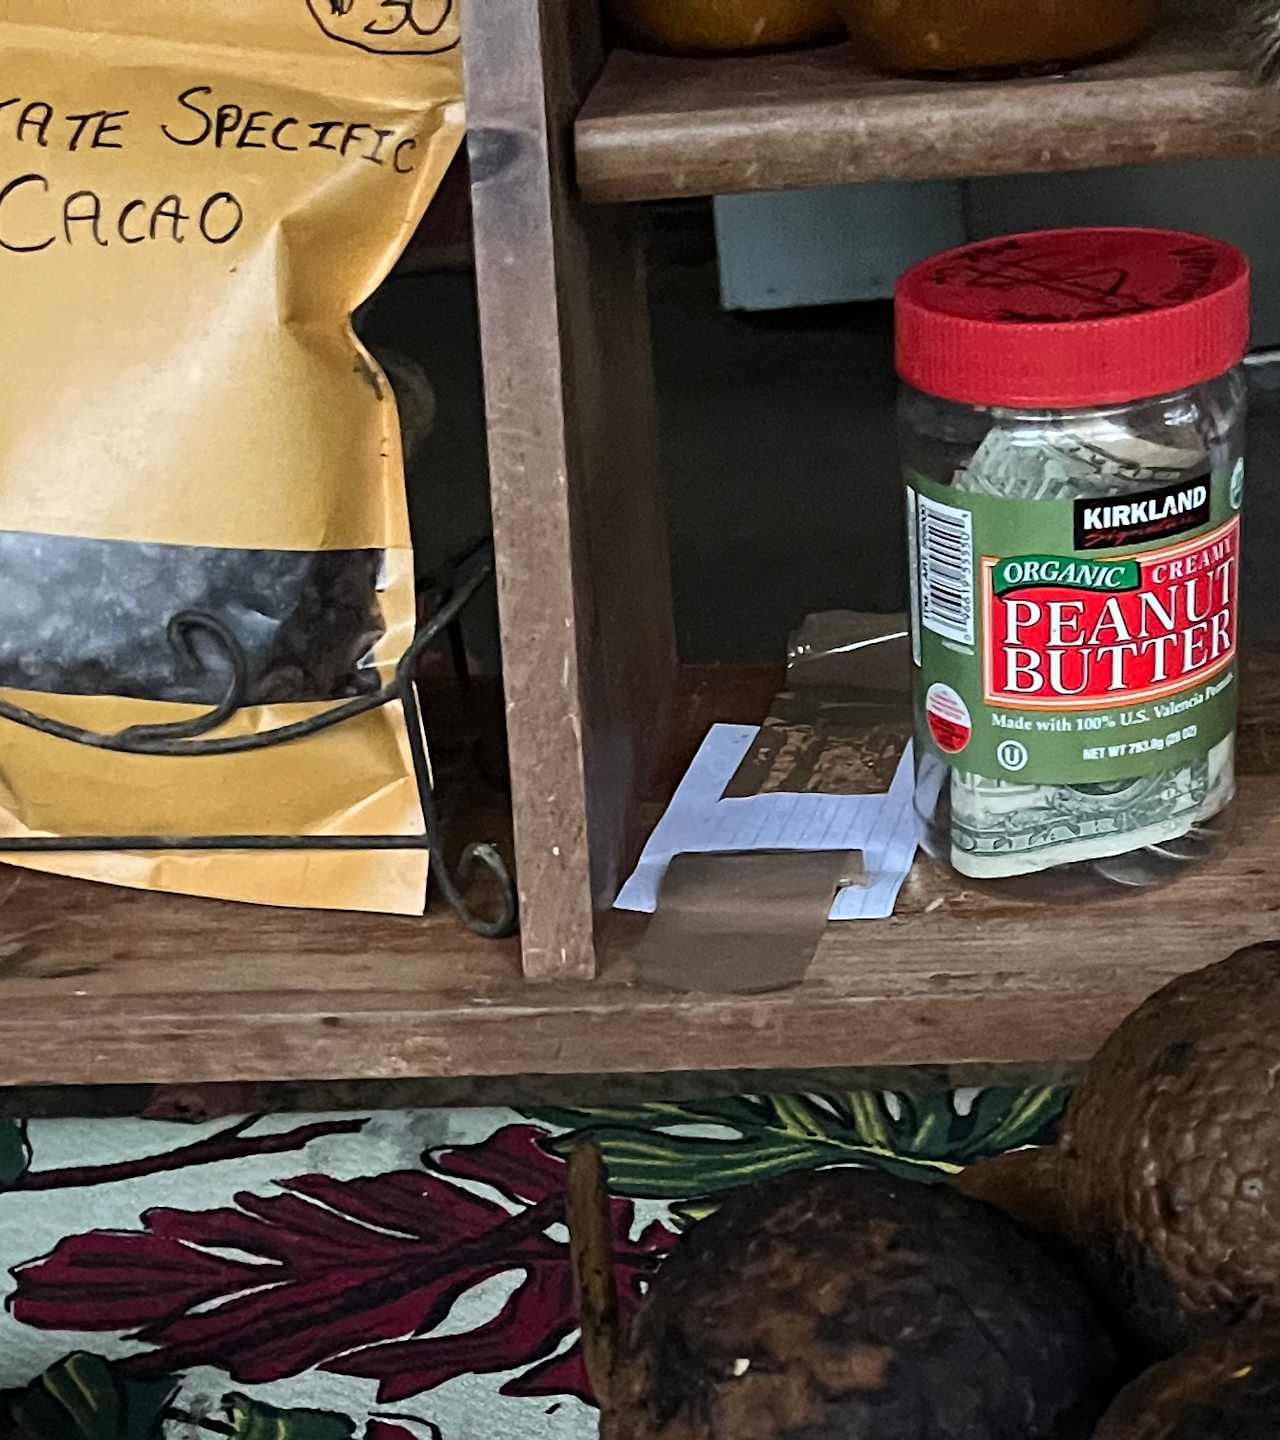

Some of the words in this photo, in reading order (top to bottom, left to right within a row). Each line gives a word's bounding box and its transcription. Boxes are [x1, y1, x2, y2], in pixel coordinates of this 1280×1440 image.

[160, 84, 416, 175] SPECIFIC
[1083, 485, 1207, 530] KIRKLAND
[1002, 560, 1126, 588] ORGANIC
[1151, 537, 1232, 584] CREAMY
[1002, 557, 1234, 647] PEANUT
[1002, 609, 1232, 695] BUTTER
[991, 712, 1033, 731] Made
[1036, 718, 1071, 732] with
[1075, 715, 1116, 731] 100%
[1120, 709, 1150, 726] U.S.
[1153, 692, 1204, 719] Valencia
[1082, 748, 1105, 761] NET
[1108, 745, 1126, 758] WT
